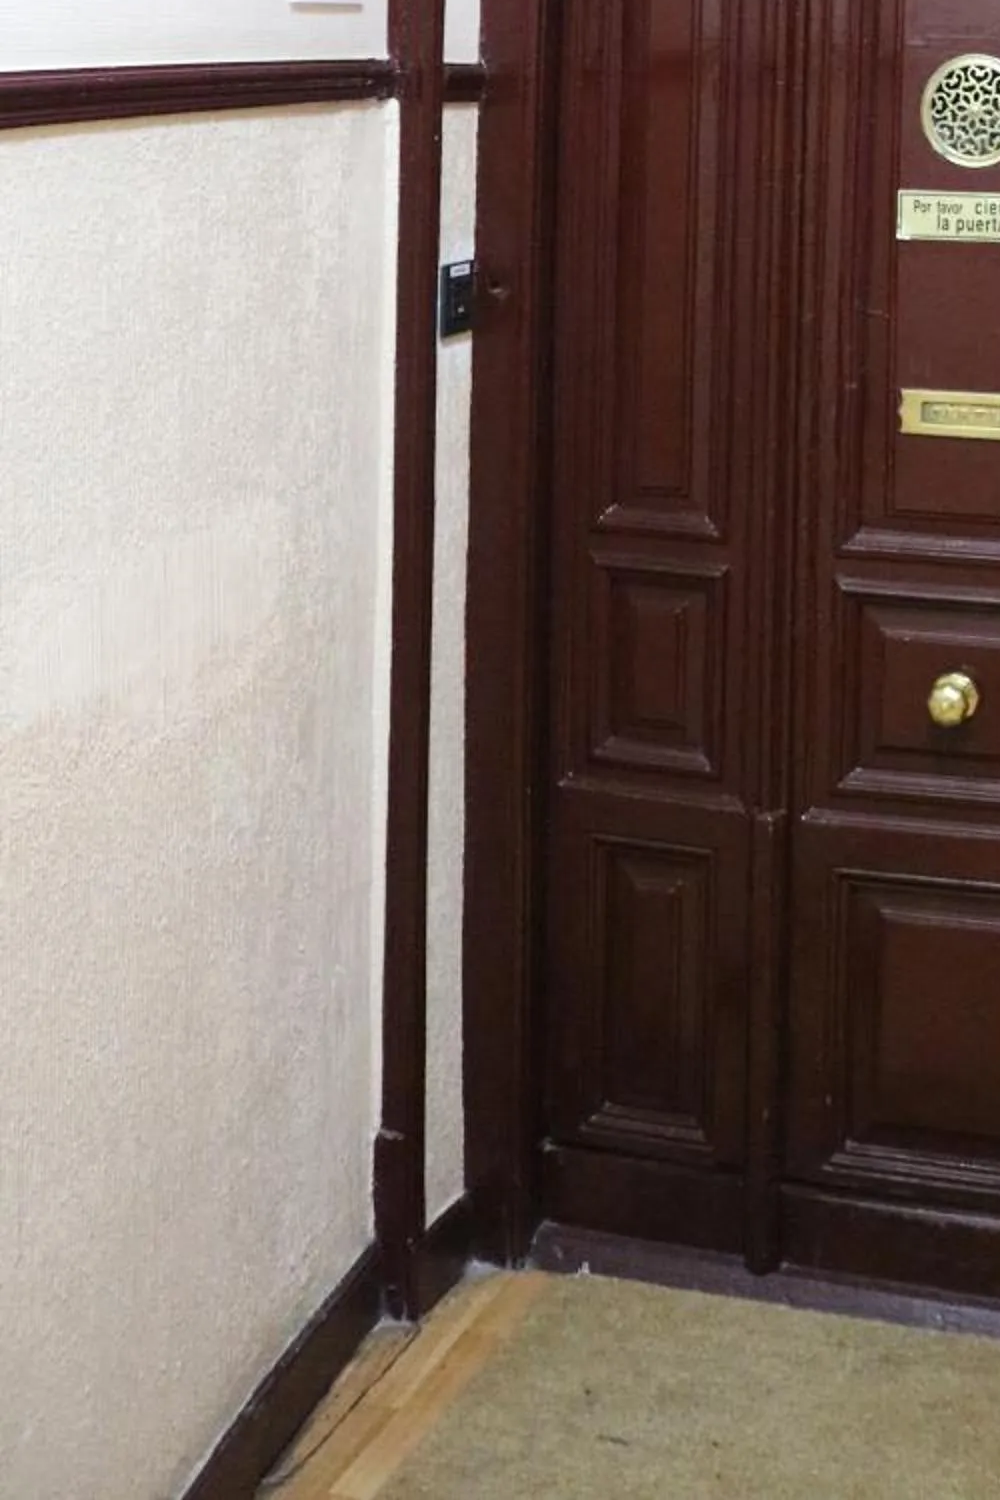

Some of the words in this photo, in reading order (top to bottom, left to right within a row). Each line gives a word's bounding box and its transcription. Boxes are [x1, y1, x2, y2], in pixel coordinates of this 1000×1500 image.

[913, 199, 932, 213] Por
[937, 201, 963, 215] favor
[937, 214, 949, 231] la
